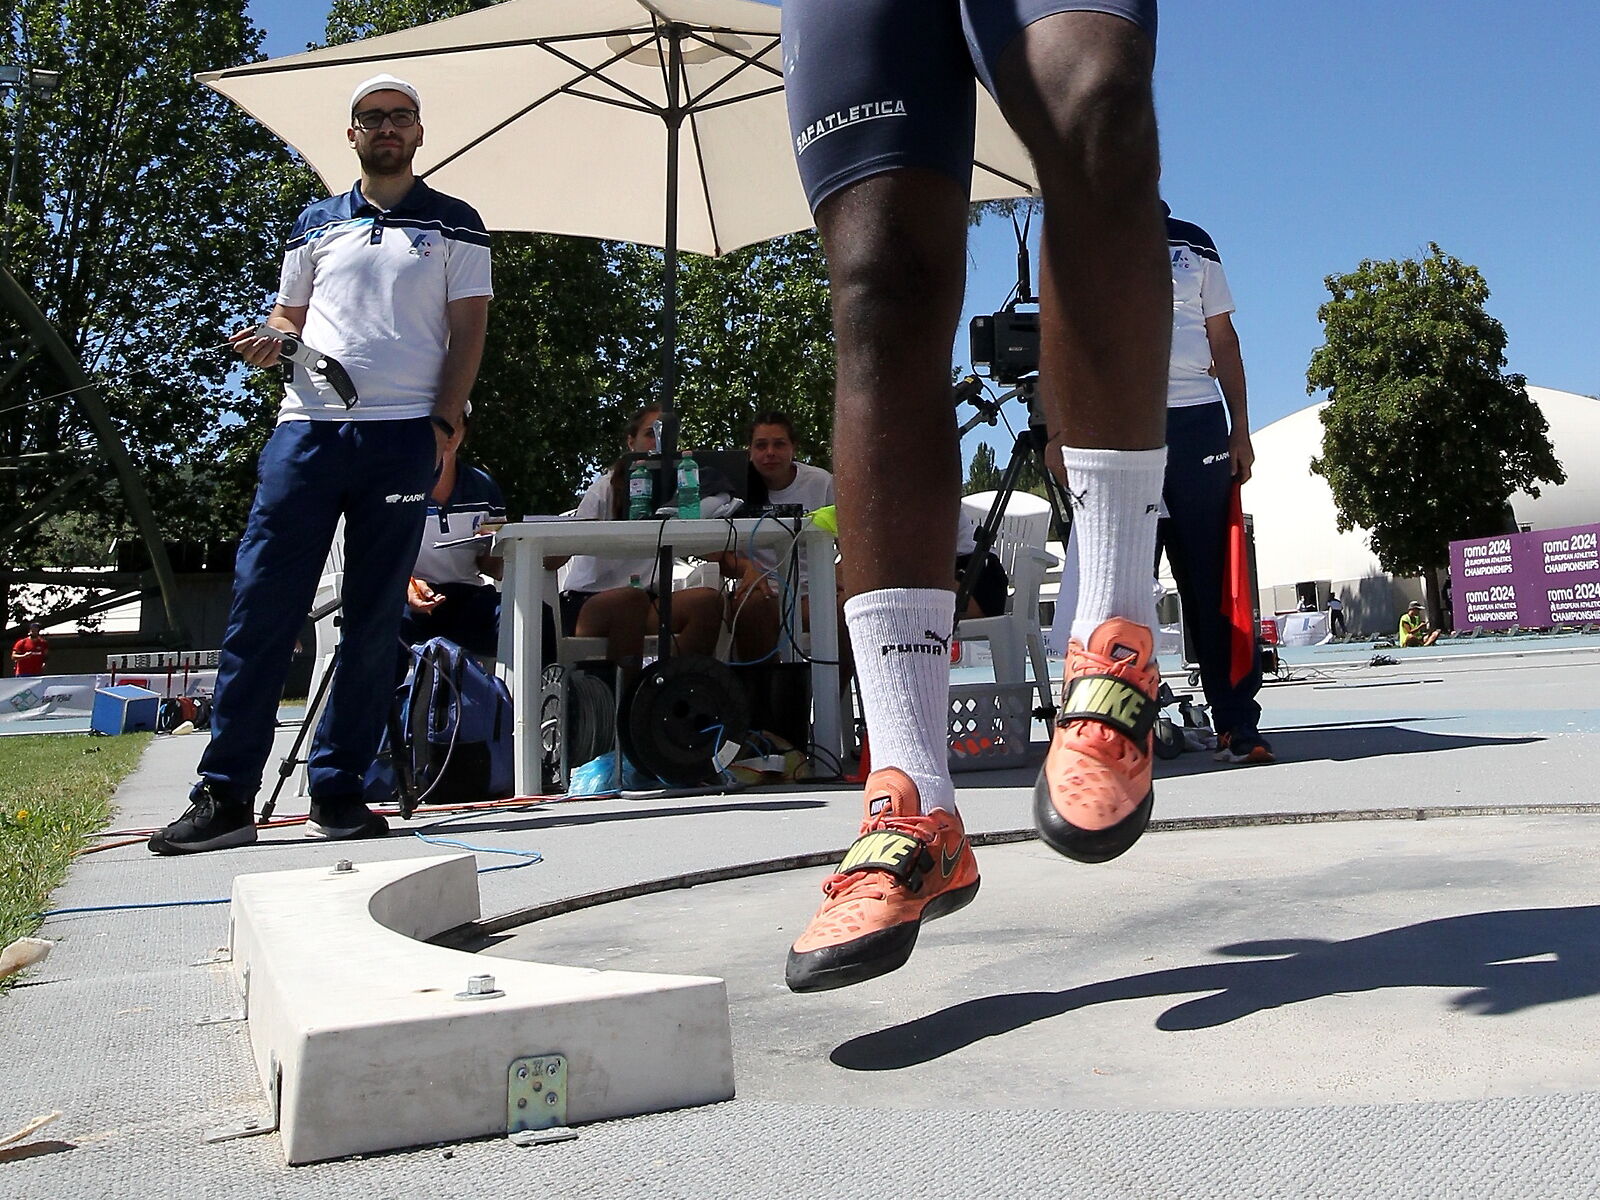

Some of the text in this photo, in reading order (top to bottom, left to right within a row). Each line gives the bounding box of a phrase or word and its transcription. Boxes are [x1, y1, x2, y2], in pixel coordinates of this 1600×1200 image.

[796, 100, 906, 153] SAFATLETICA
[1463, 538, 1511, 558] roma 2024
[1543, 532, 1597, 554] roma 2024
[1464, 563, 1513, 577] CHAMPIONSHIPS
[1544, 559, 1600, 574] CHAMPIONSHIPS
[1465, 585, 1515, 603] roma 2024
[1547, 582, 1600, 602] roma 2024
[1468, 610, 1518, 623] CHAMPIONSHIPS
[882, 643, 943, 656] PUMA
[1064, 677, 1146, 729] NIKE
[835, 831, 918, 875] NIKE
